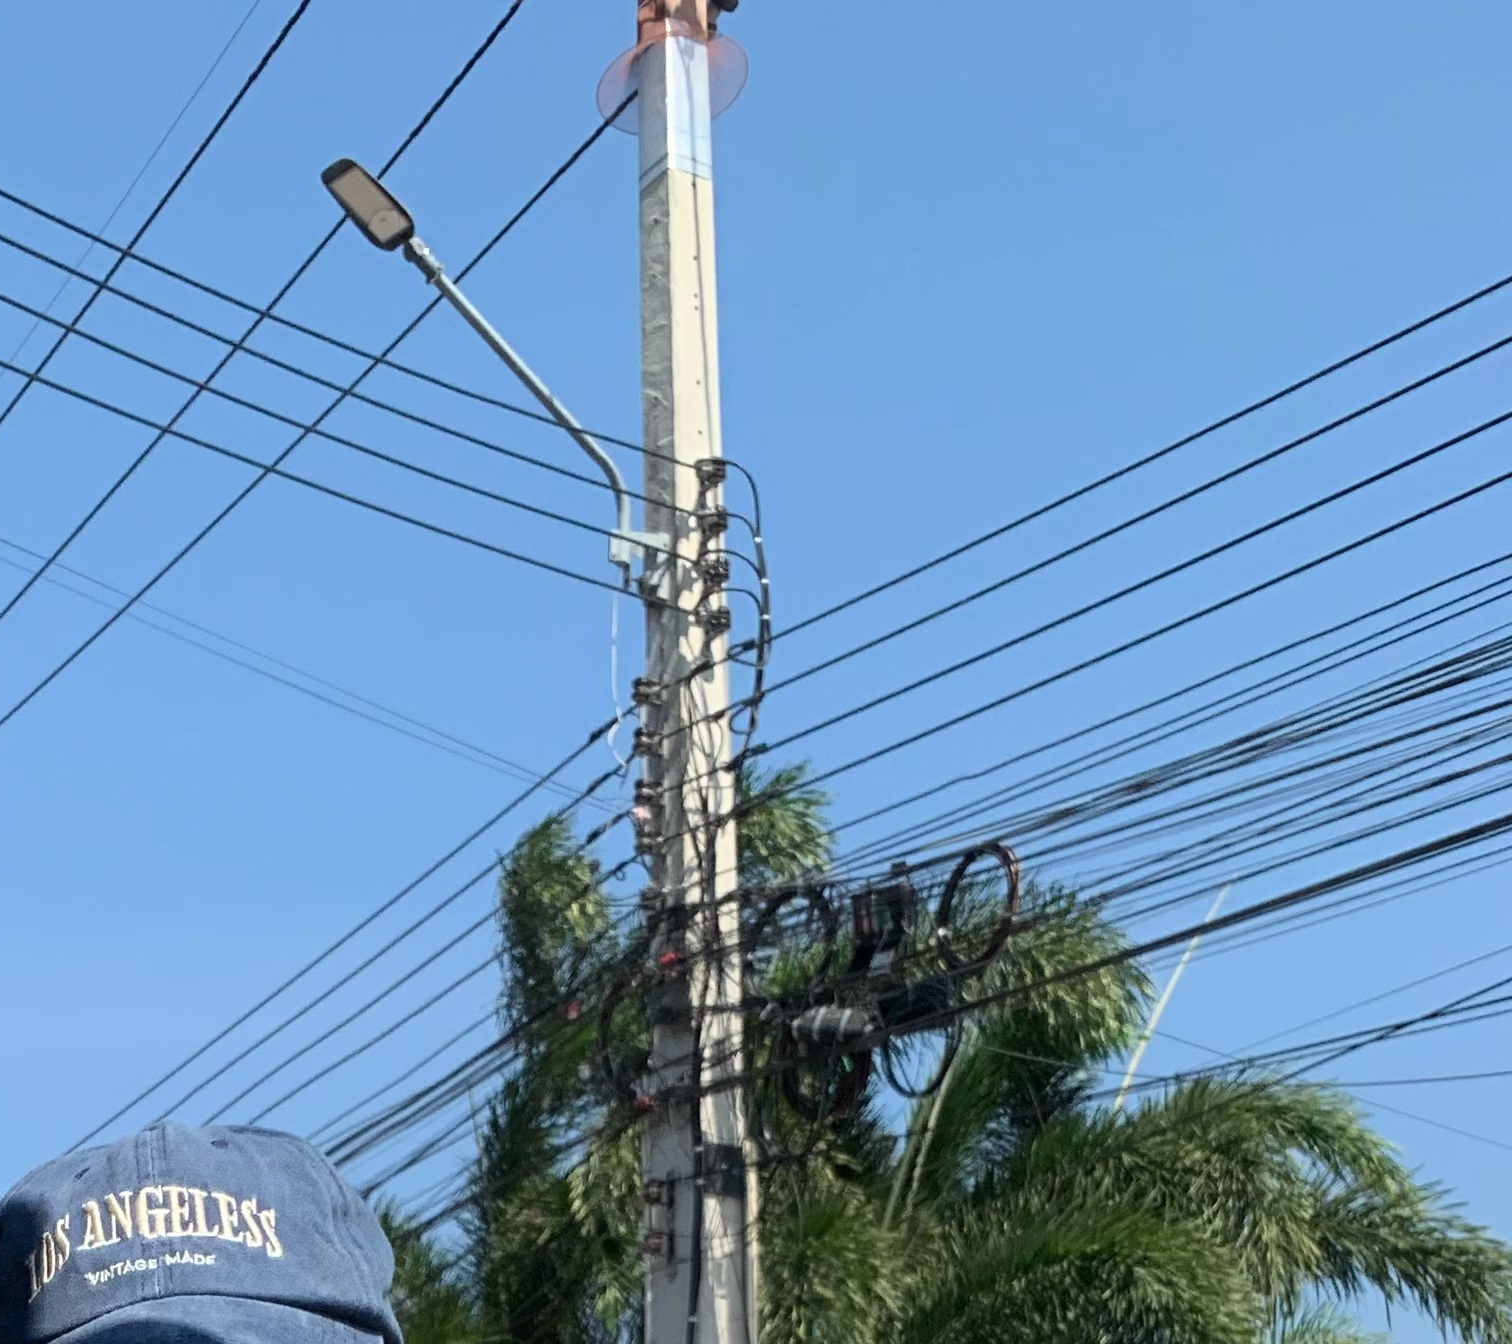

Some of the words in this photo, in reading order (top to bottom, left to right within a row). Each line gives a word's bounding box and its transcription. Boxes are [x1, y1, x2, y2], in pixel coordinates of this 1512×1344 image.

[28, 1212, 71, 1303] LOS
[76, 1184, 284, 1259] ANGELESS
[83, 1257, 159, 1286] VINTAGE
[163, 1249, 217, 1266] MADE
